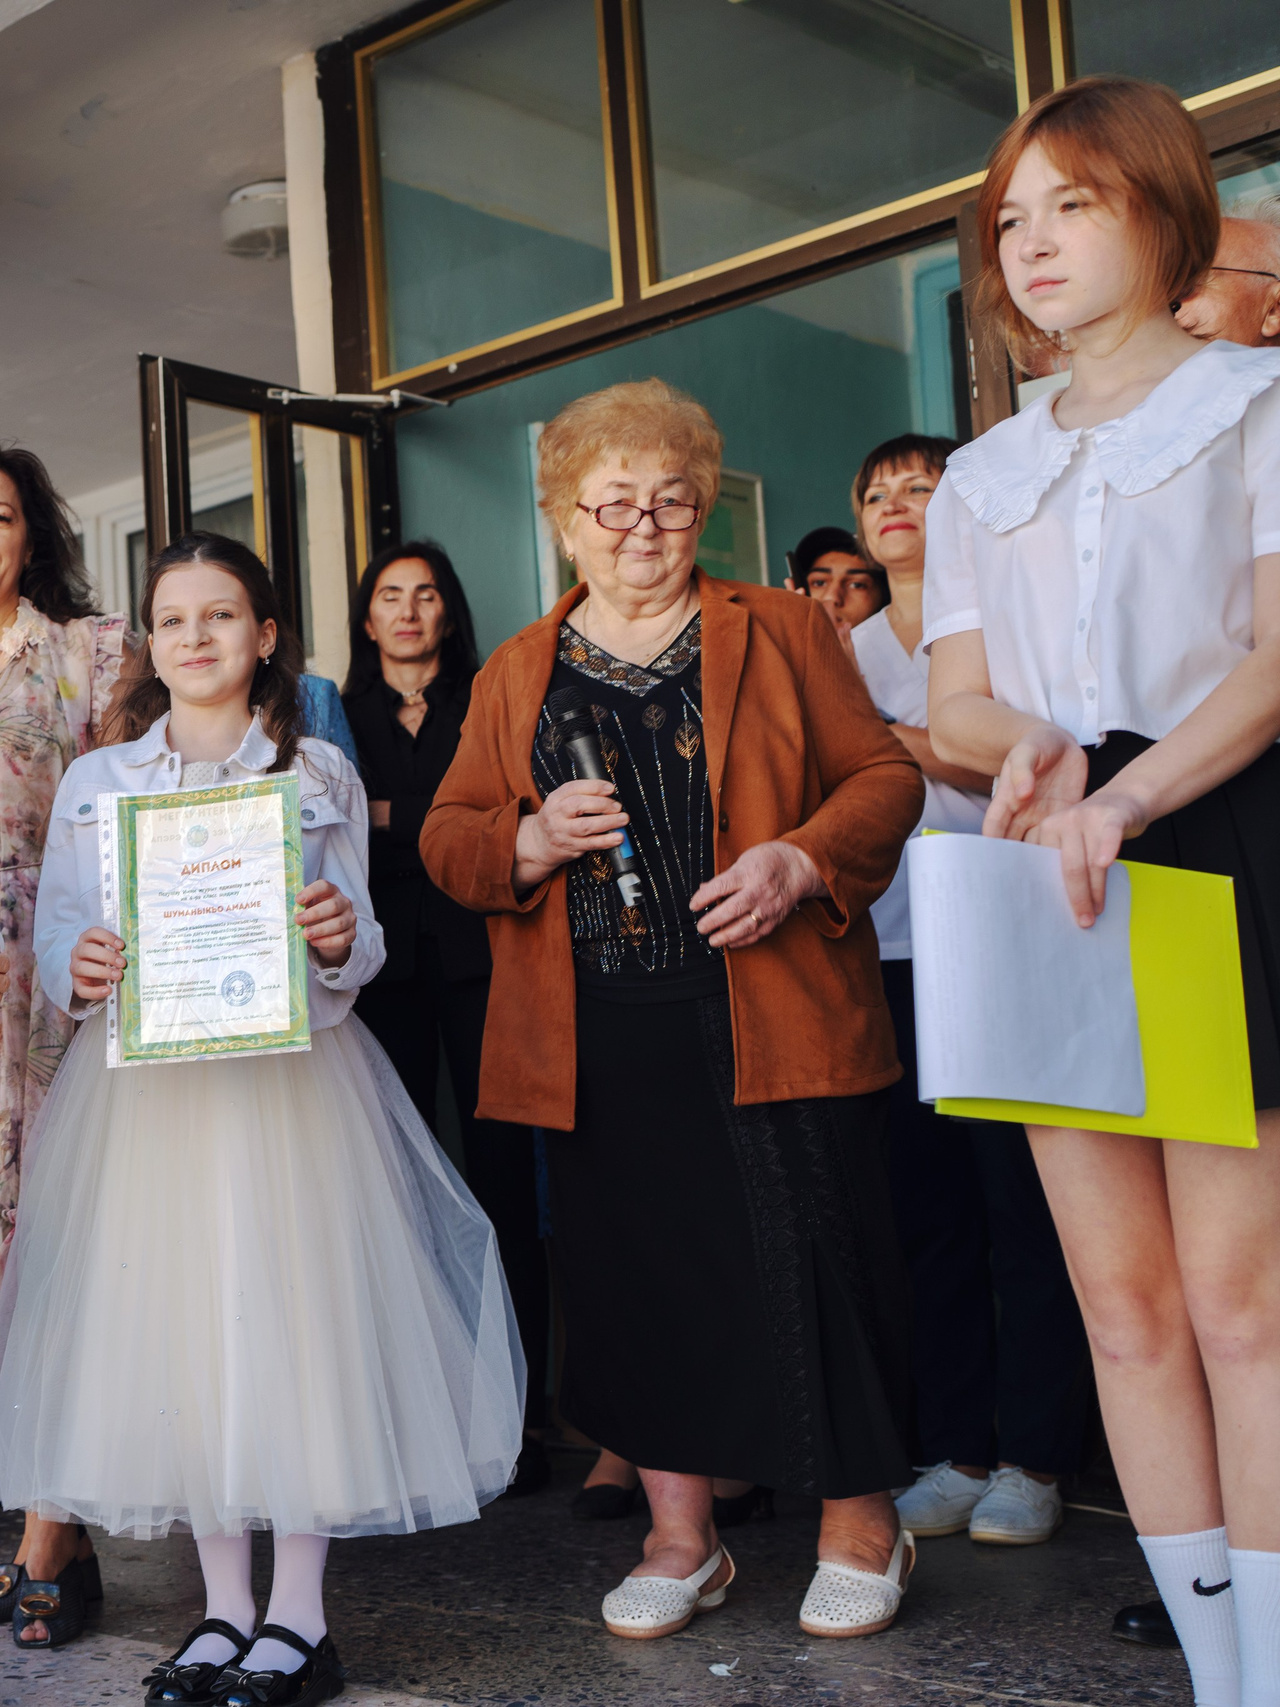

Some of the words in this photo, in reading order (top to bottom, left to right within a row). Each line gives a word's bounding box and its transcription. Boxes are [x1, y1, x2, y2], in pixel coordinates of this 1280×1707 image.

[181, 858, 242, 876] ДИПЛОМ
[163, 906, 223, 918] ШУМАНЫКЪО
[225, 901, 261, 912] АМАЛИЕ
